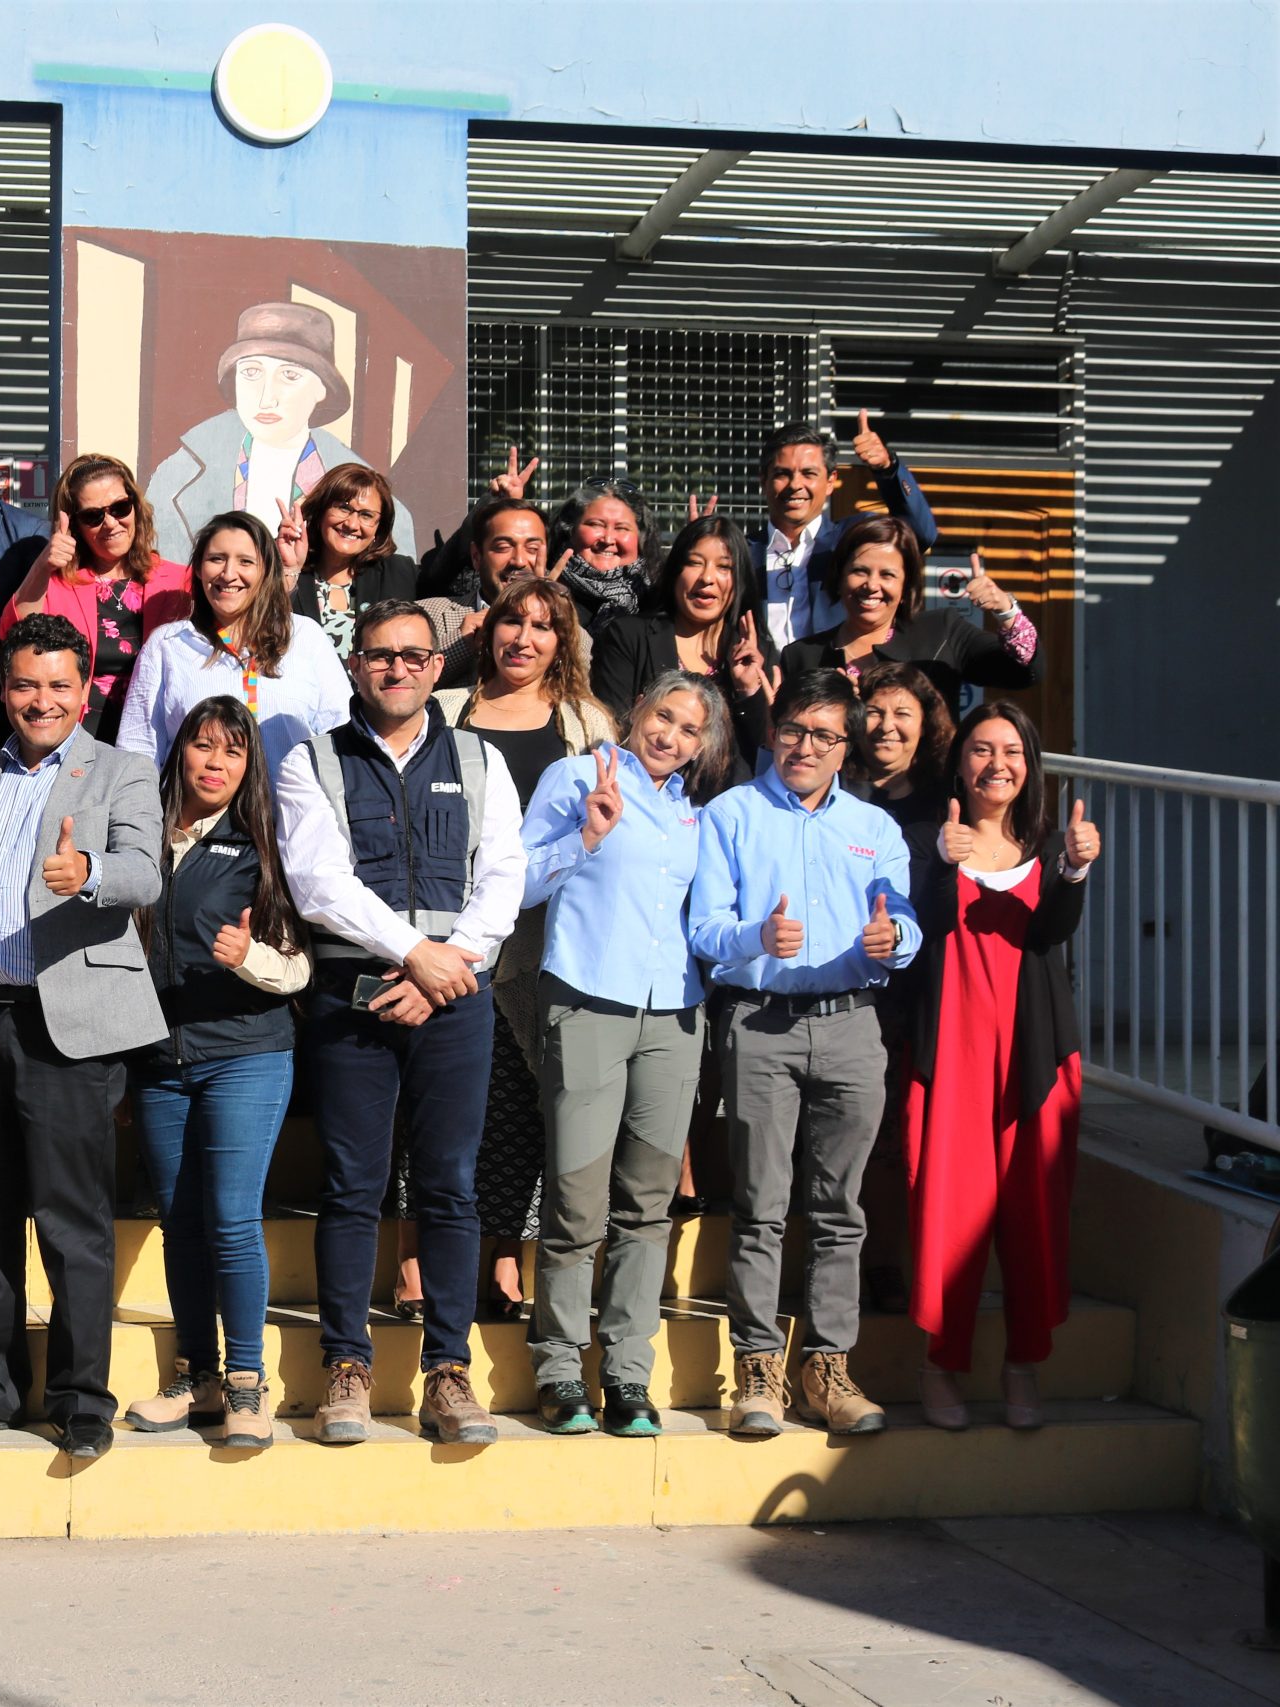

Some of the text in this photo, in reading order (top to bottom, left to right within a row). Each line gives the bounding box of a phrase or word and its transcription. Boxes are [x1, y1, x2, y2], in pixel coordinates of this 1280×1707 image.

[431, 782, 461, 793] EMIN
[210, 844, 240, 857] EMIN
[848, 845, 876, 856] THM
